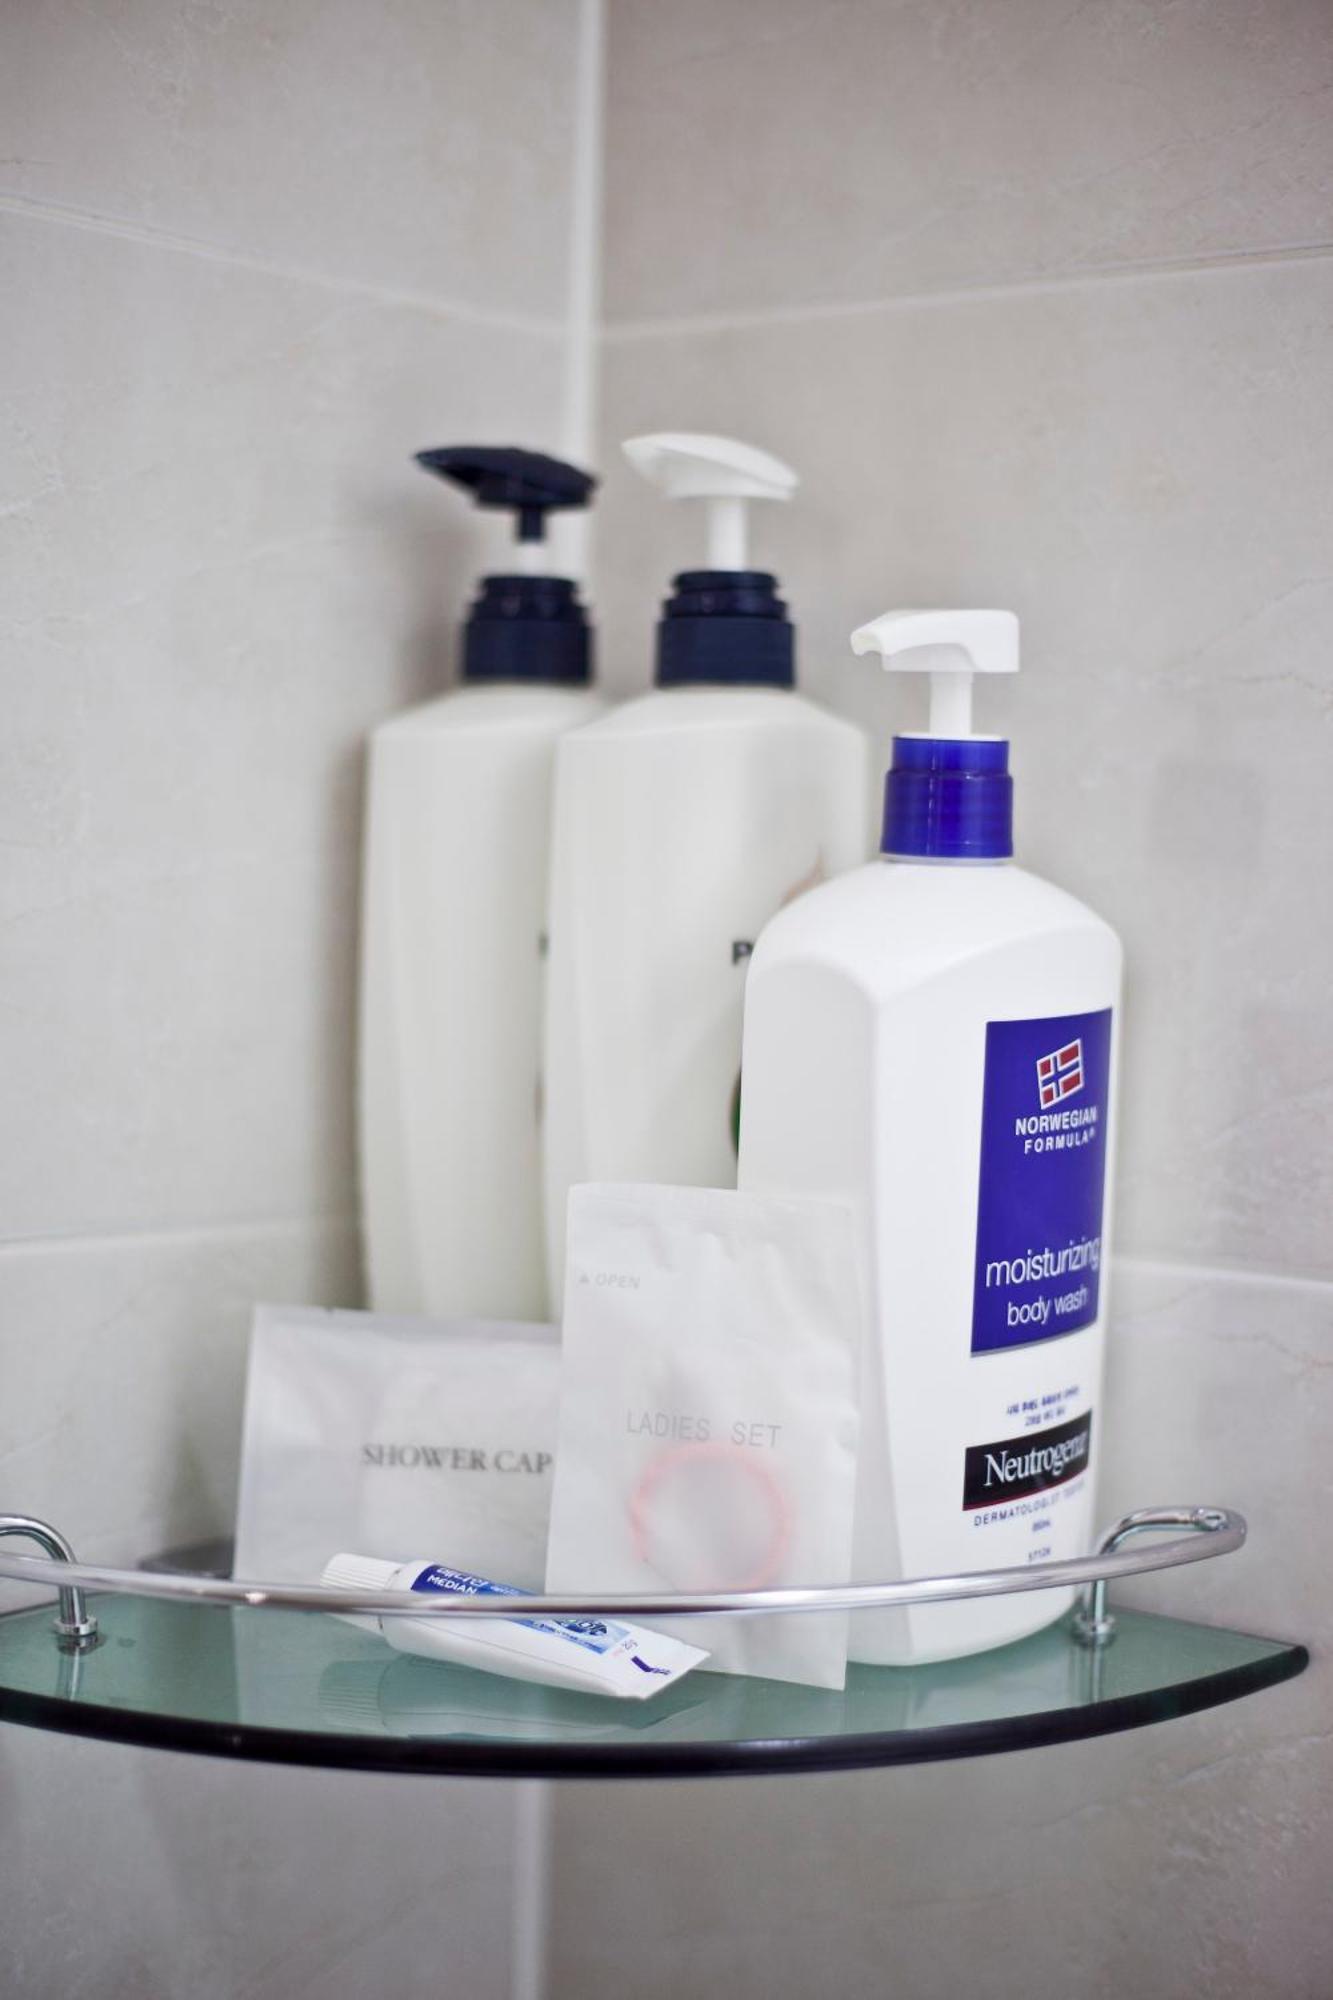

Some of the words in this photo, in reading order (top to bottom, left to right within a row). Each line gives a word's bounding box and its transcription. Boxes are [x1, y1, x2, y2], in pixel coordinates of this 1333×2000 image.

[1015, 1106, 1097, 1135] NORWEGIAN
[985, 1237, 1100, 1287] moisturizing
[595, 1272, 641, 1290] OPEN
[1007, 1295, 1051, 1326] body
[1054, 1284, 1088, 1315] wash
[627, 1409, 711, 1442] LADIES
[731, 1421, 783, 1448] SET
[361, 1443, 489, 1472] SHOWER
[493, 1449, 553, 1475] CAP
[427, 1574, 478, 1595] MEDIAN
